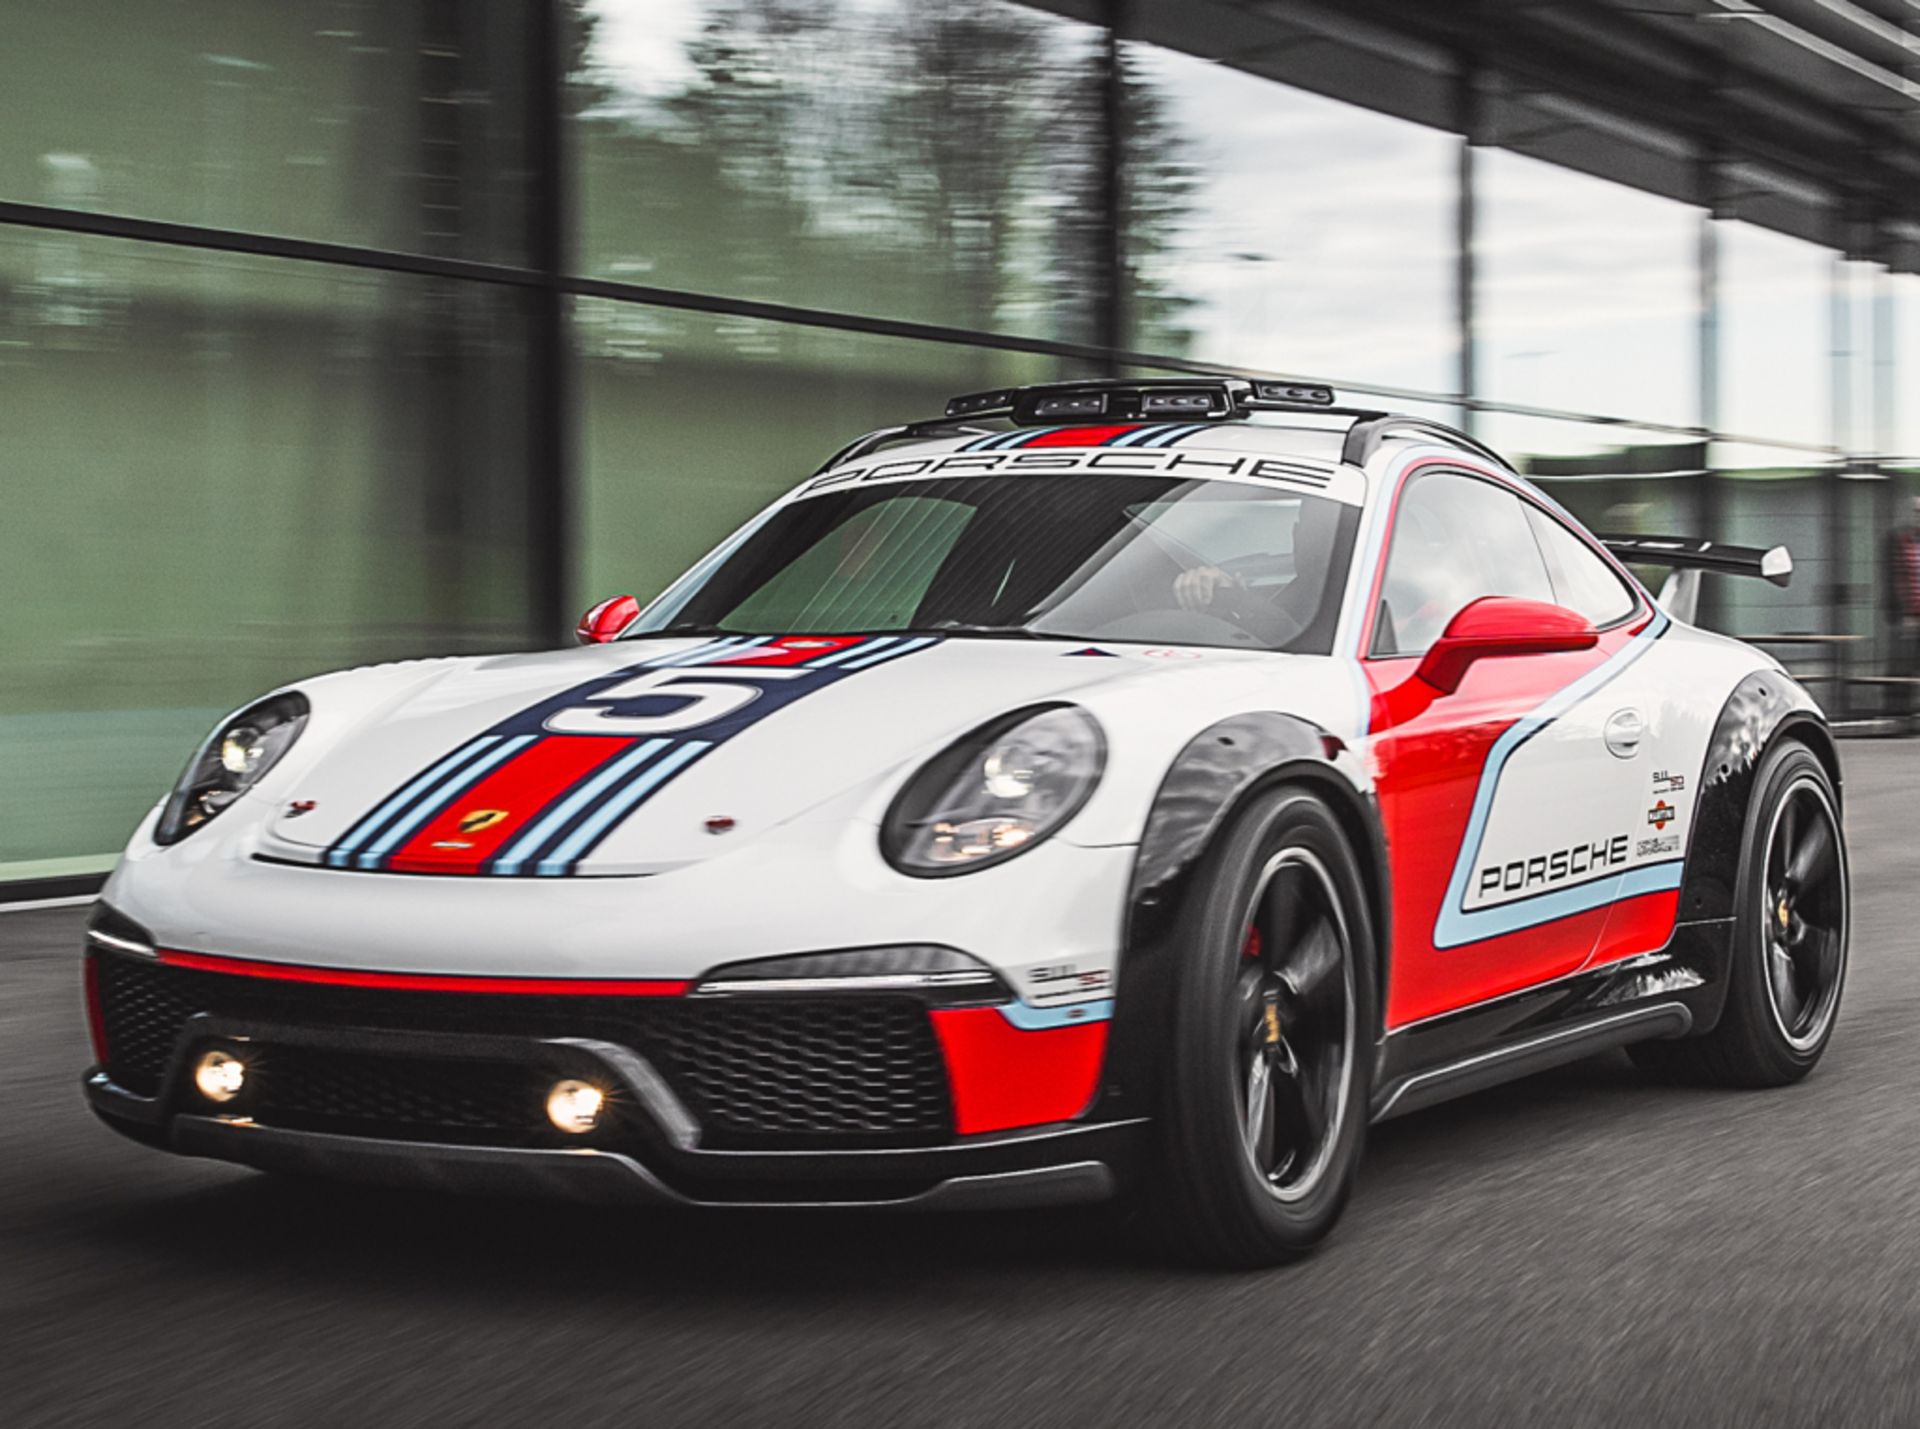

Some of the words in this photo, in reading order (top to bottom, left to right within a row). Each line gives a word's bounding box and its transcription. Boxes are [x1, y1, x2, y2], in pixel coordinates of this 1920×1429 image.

[799, 452, 1335, 497] PORSCHE
[541, 667, 815, 734] 5
[1479, 835, 1628, 898] PORSCHE
